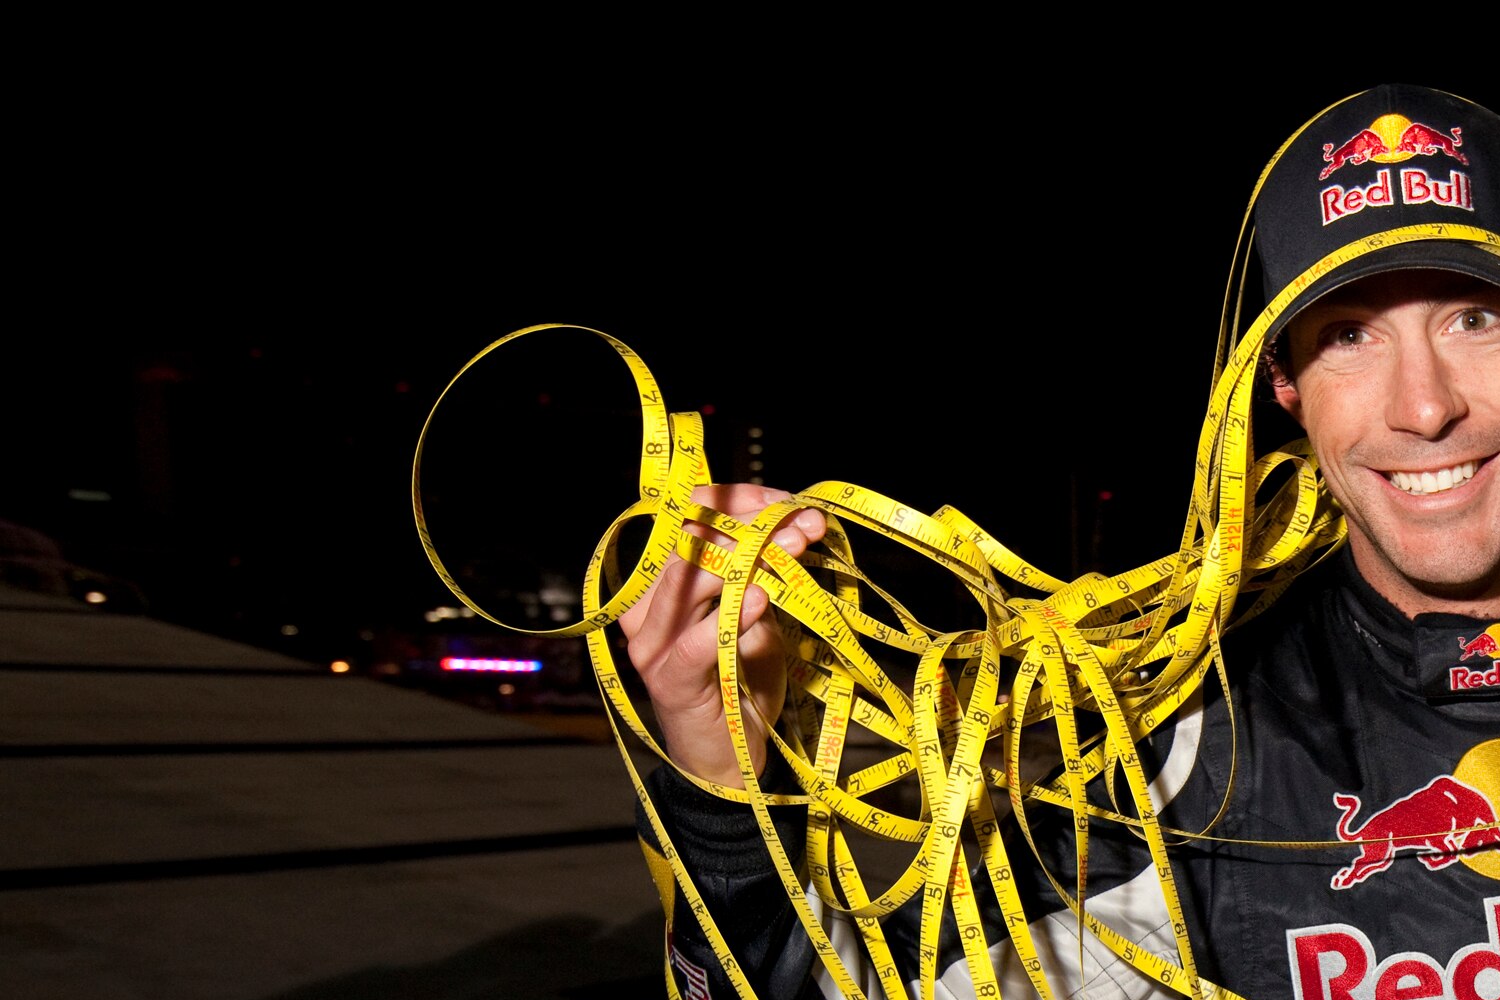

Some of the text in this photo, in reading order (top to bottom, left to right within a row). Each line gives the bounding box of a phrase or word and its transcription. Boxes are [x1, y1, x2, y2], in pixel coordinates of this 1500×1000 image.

[1320, 168, 1475, 226] Red Bull
[1295, 274, 1308, 288] ft
[643, 391, 658, 404] 7
[645, 442, 663, 455] 8
[1227, 507, 1242, 551] 212 ft
[1292, 514, 1310, 534] 10
[702, 550, 724, 571] 90
[764, 545, 806, 591] 92 ft
[1153, 562, 1175, 578] 10
[1085, 593, 1097, 608] 8
[858, 710, 872, 723] 2
[823, 715, 845, 765] 126 ft
[996, 868, 1010, 881] 8
